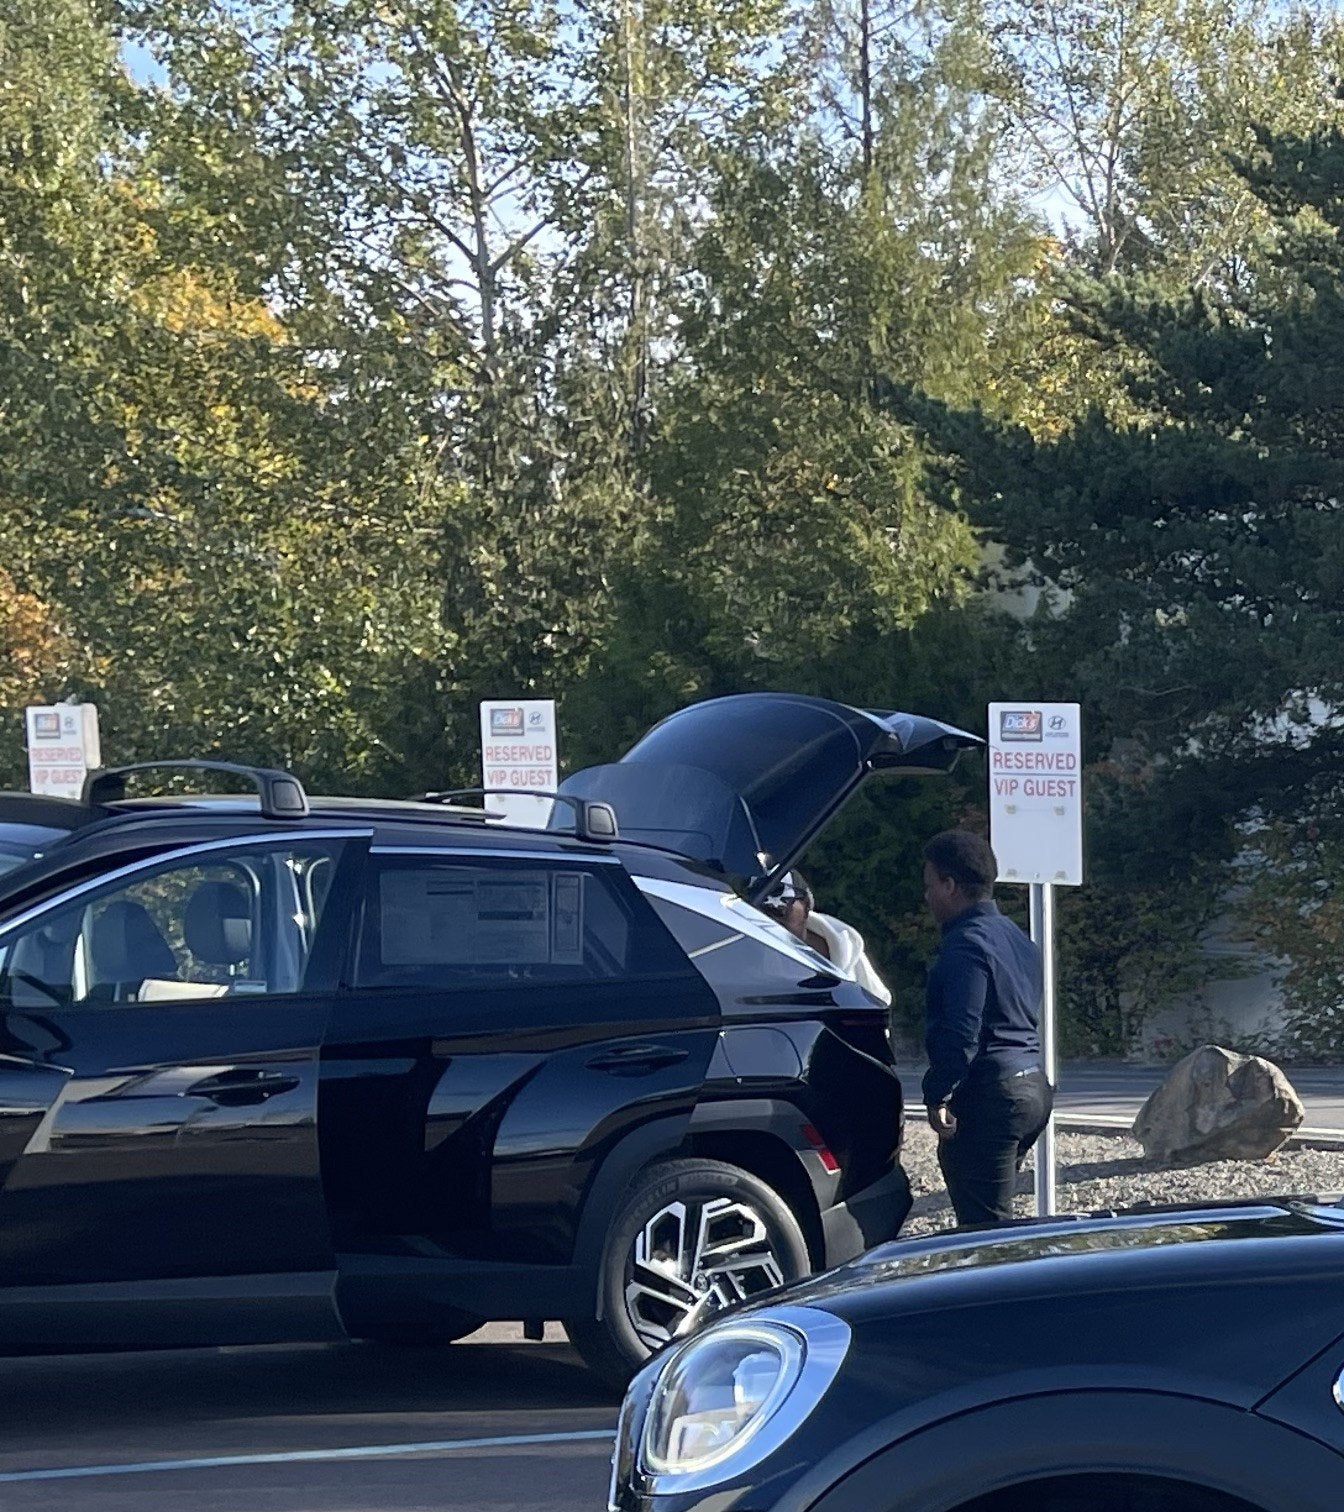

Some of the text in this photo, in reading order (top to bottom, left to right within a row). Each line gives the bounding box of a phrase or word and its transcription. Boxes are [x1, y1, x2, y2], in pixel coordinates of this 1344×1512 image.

[485, 745, 552, 762] RESERVED
[993, 752, 1076, 770] RESERVED
[487, 769, 552, 787] VIP GUEST
[994, 778, 1076, 798] VIP GUEST
